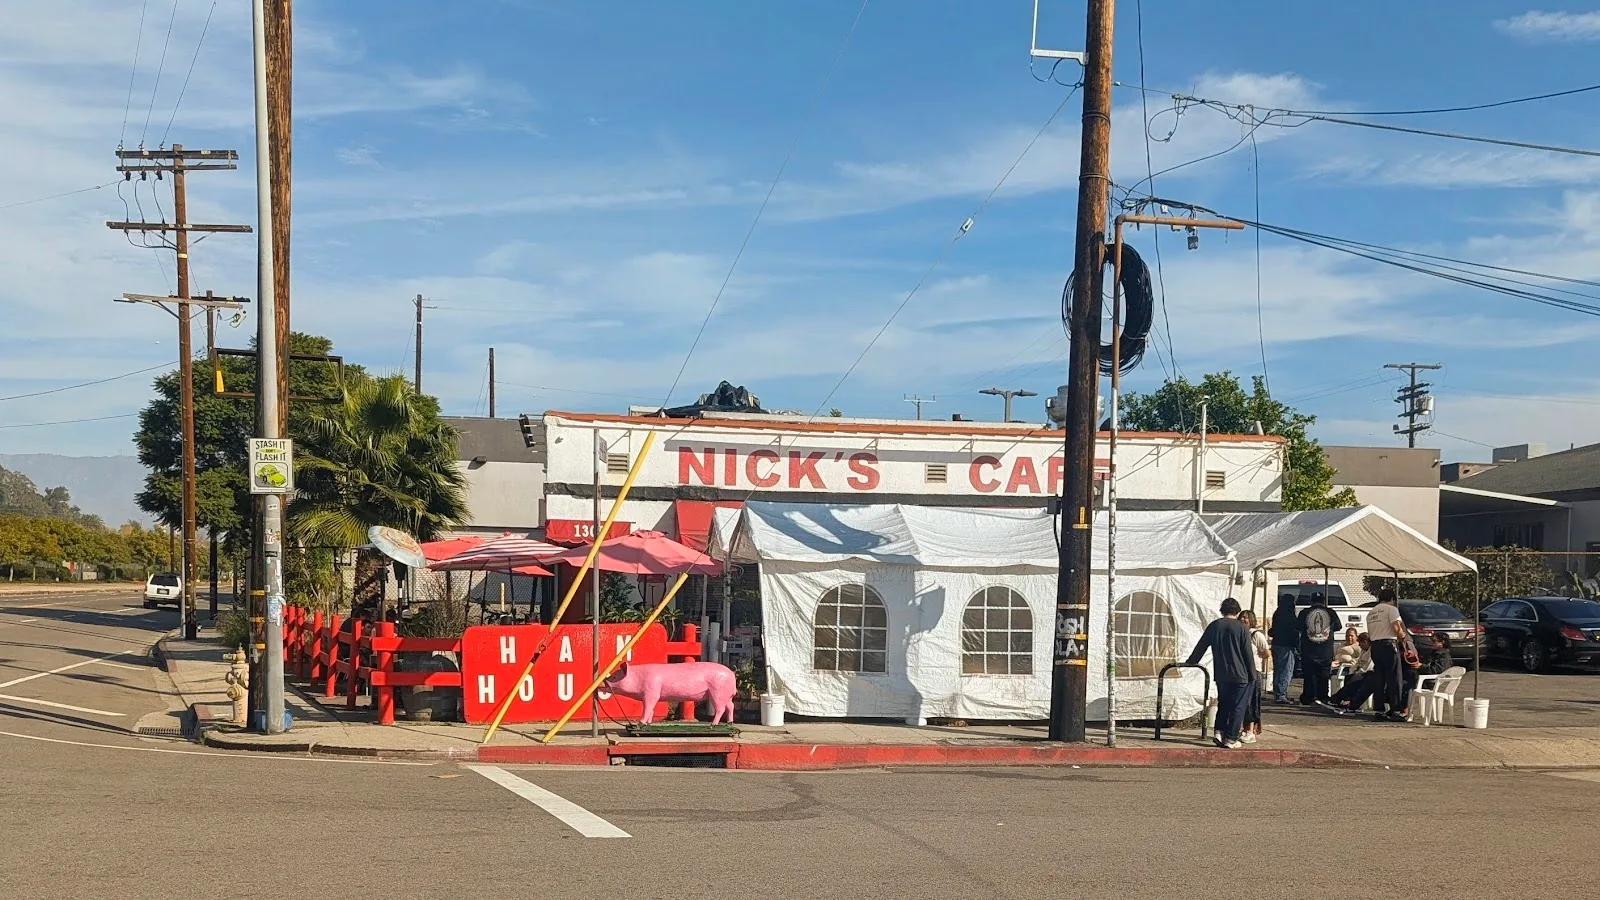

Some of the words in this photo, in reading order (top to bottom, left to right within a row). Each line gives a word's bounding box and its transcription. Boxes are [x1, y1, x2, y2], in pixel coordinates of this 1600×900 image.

[255, 440, 278, 450] STASH
[280, 440, 286, 450] IT
[255, 452, 278, 461] FLASH
[280, 452, 287, 461] IT
[678, 448, 880, 491] NICK'S
